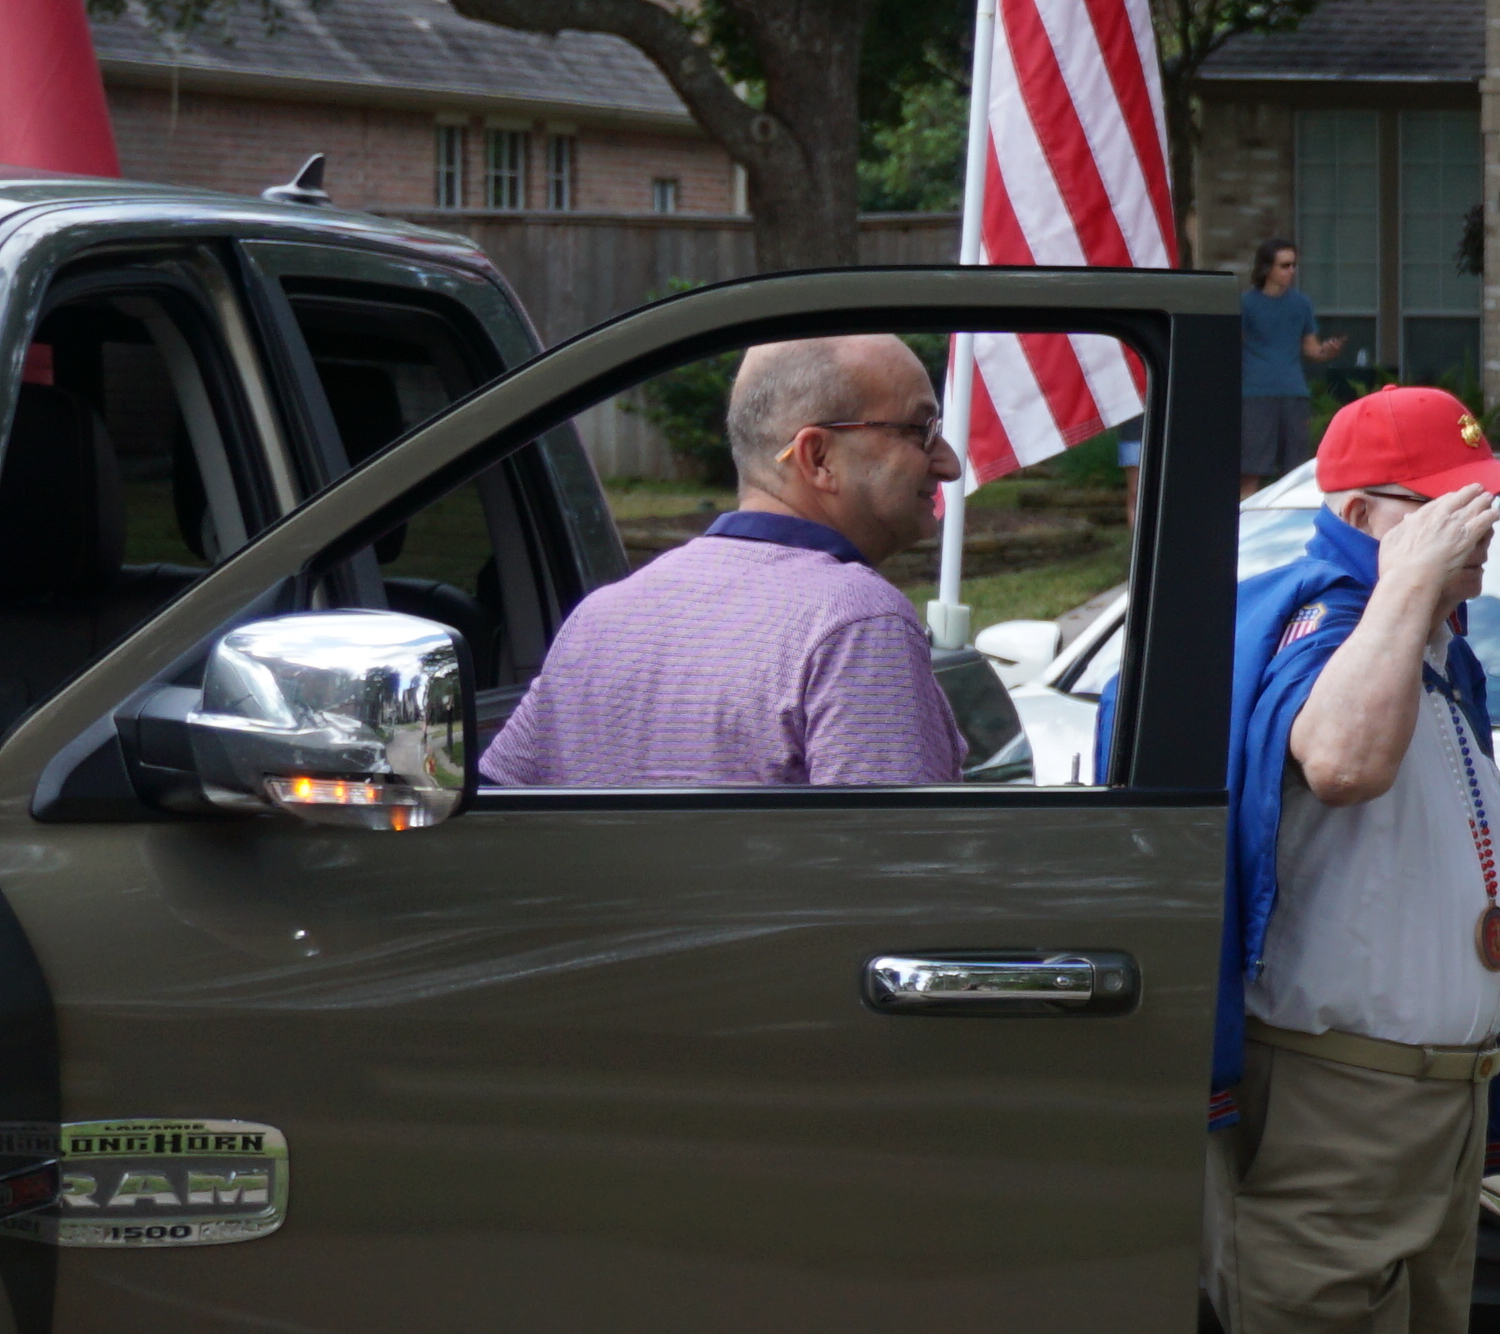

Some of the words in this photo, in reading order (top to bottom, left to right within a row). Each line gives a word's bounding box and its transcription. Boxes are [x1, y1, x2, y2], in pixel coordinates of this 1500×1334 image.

[62, 1134, 265, 1154] ONGHORN
[61, 1168, 269, 1207] RAM
[110, 1225, 193, 1239] 1500
